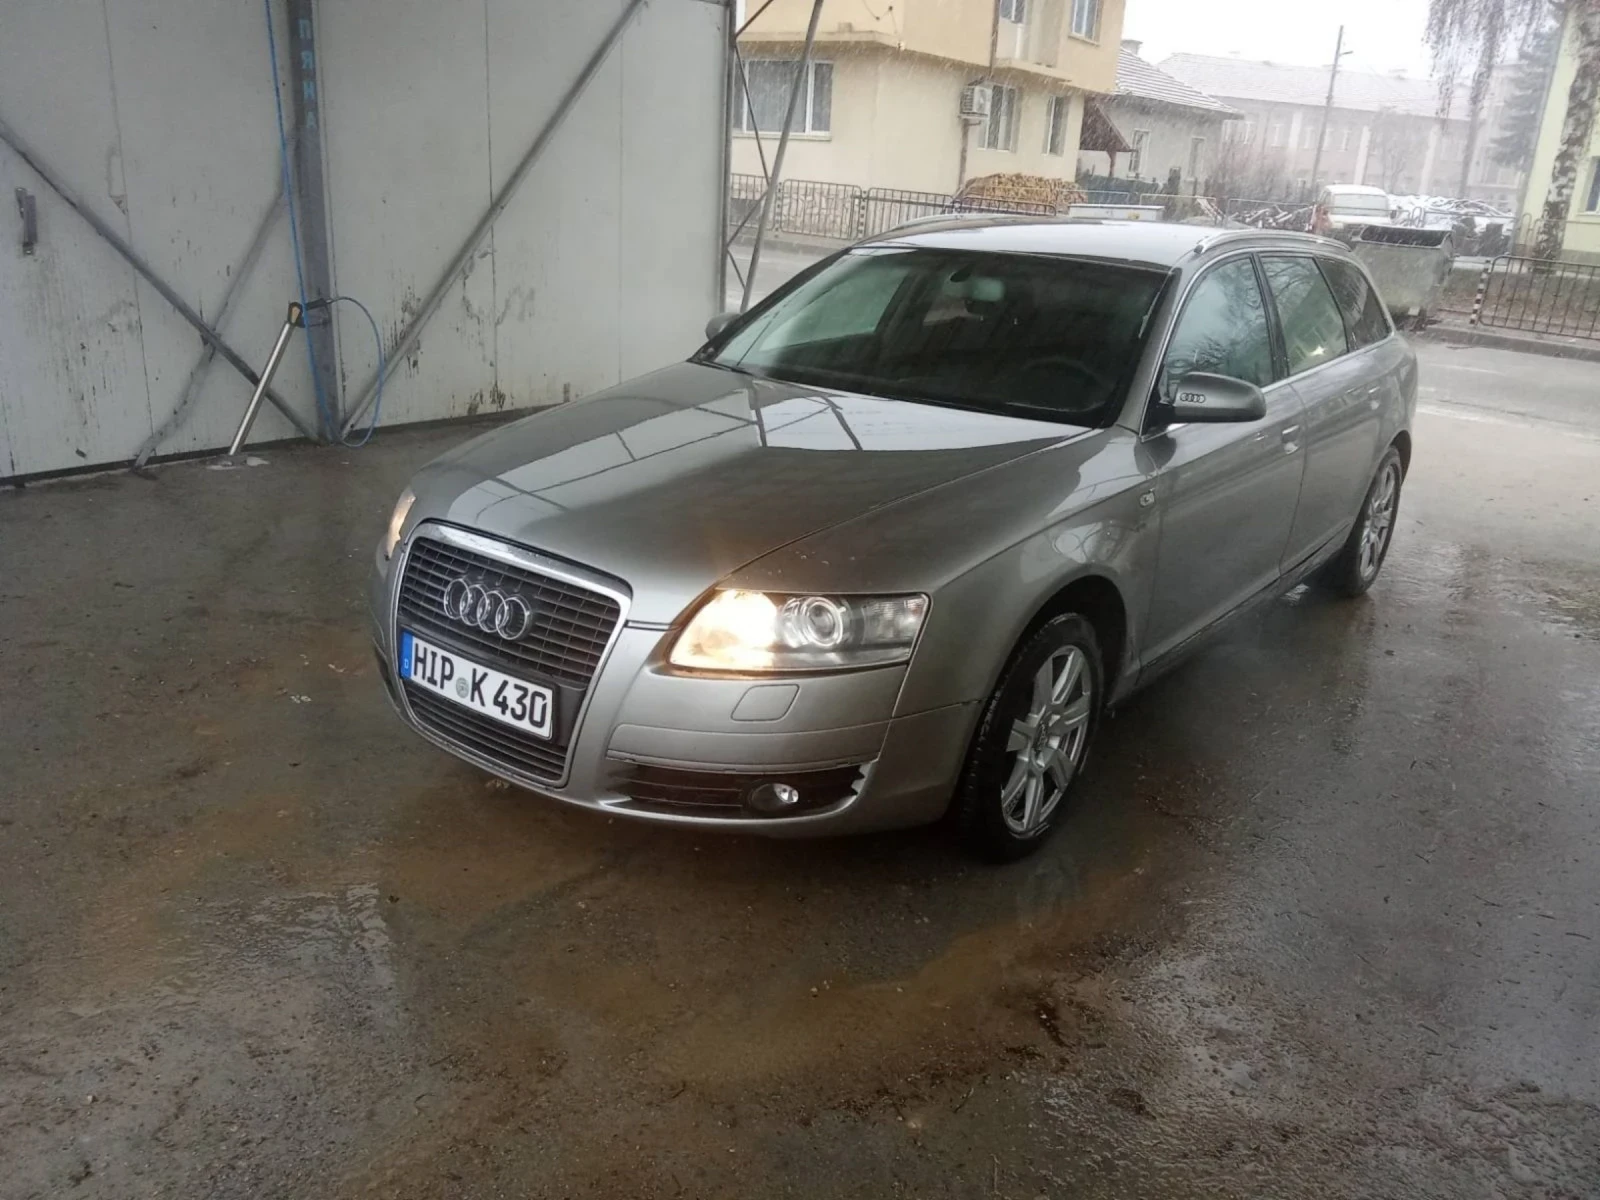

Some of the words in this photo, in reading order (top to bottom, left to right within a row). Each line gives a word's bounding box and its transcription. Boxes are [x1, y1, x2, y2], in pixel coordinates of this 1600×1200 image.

[414, 643, 454, 689] HIP
[470, 668, 488, 707] K
[493, 680, 547, 729] 430
